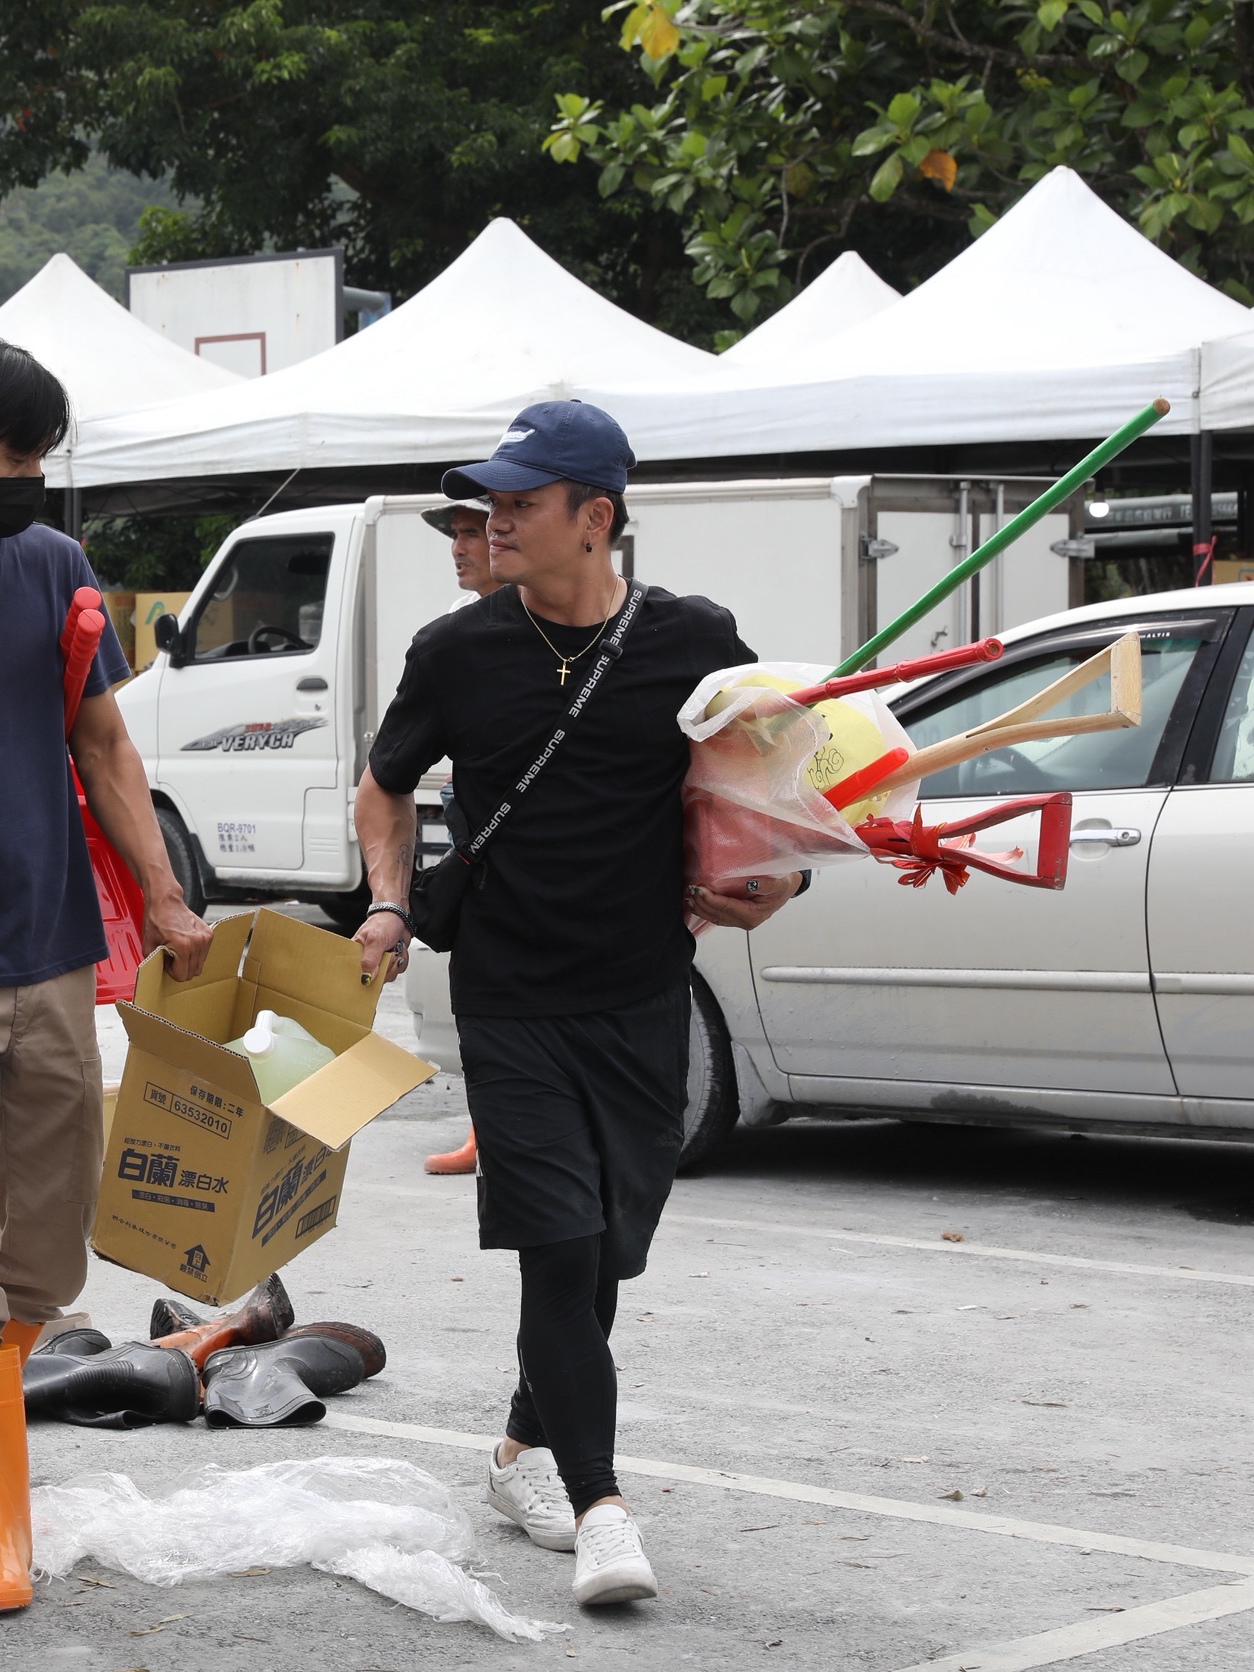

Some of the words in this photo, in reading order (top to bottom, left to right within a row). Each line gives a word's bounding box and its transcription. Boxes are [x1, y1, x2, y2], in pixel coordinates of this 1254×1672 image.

[610, 589, 643, 647] SUPREME
[568, 655, 611, 718] SUPREME
[221, 732, 295, 752] VERYCA
[516, 729, 566, 793] SUPREME
[217, 822, 256, 834] BQR-9701
[467, 802, 512, 854] SUPREM
[150, 1089, 167, 1105] 貨號
[174, 1100, 228, 1133] 63532010
[118, 1148, 180, 1188] 白蘭
[178, 1169, 229, 1194] 漂白水
